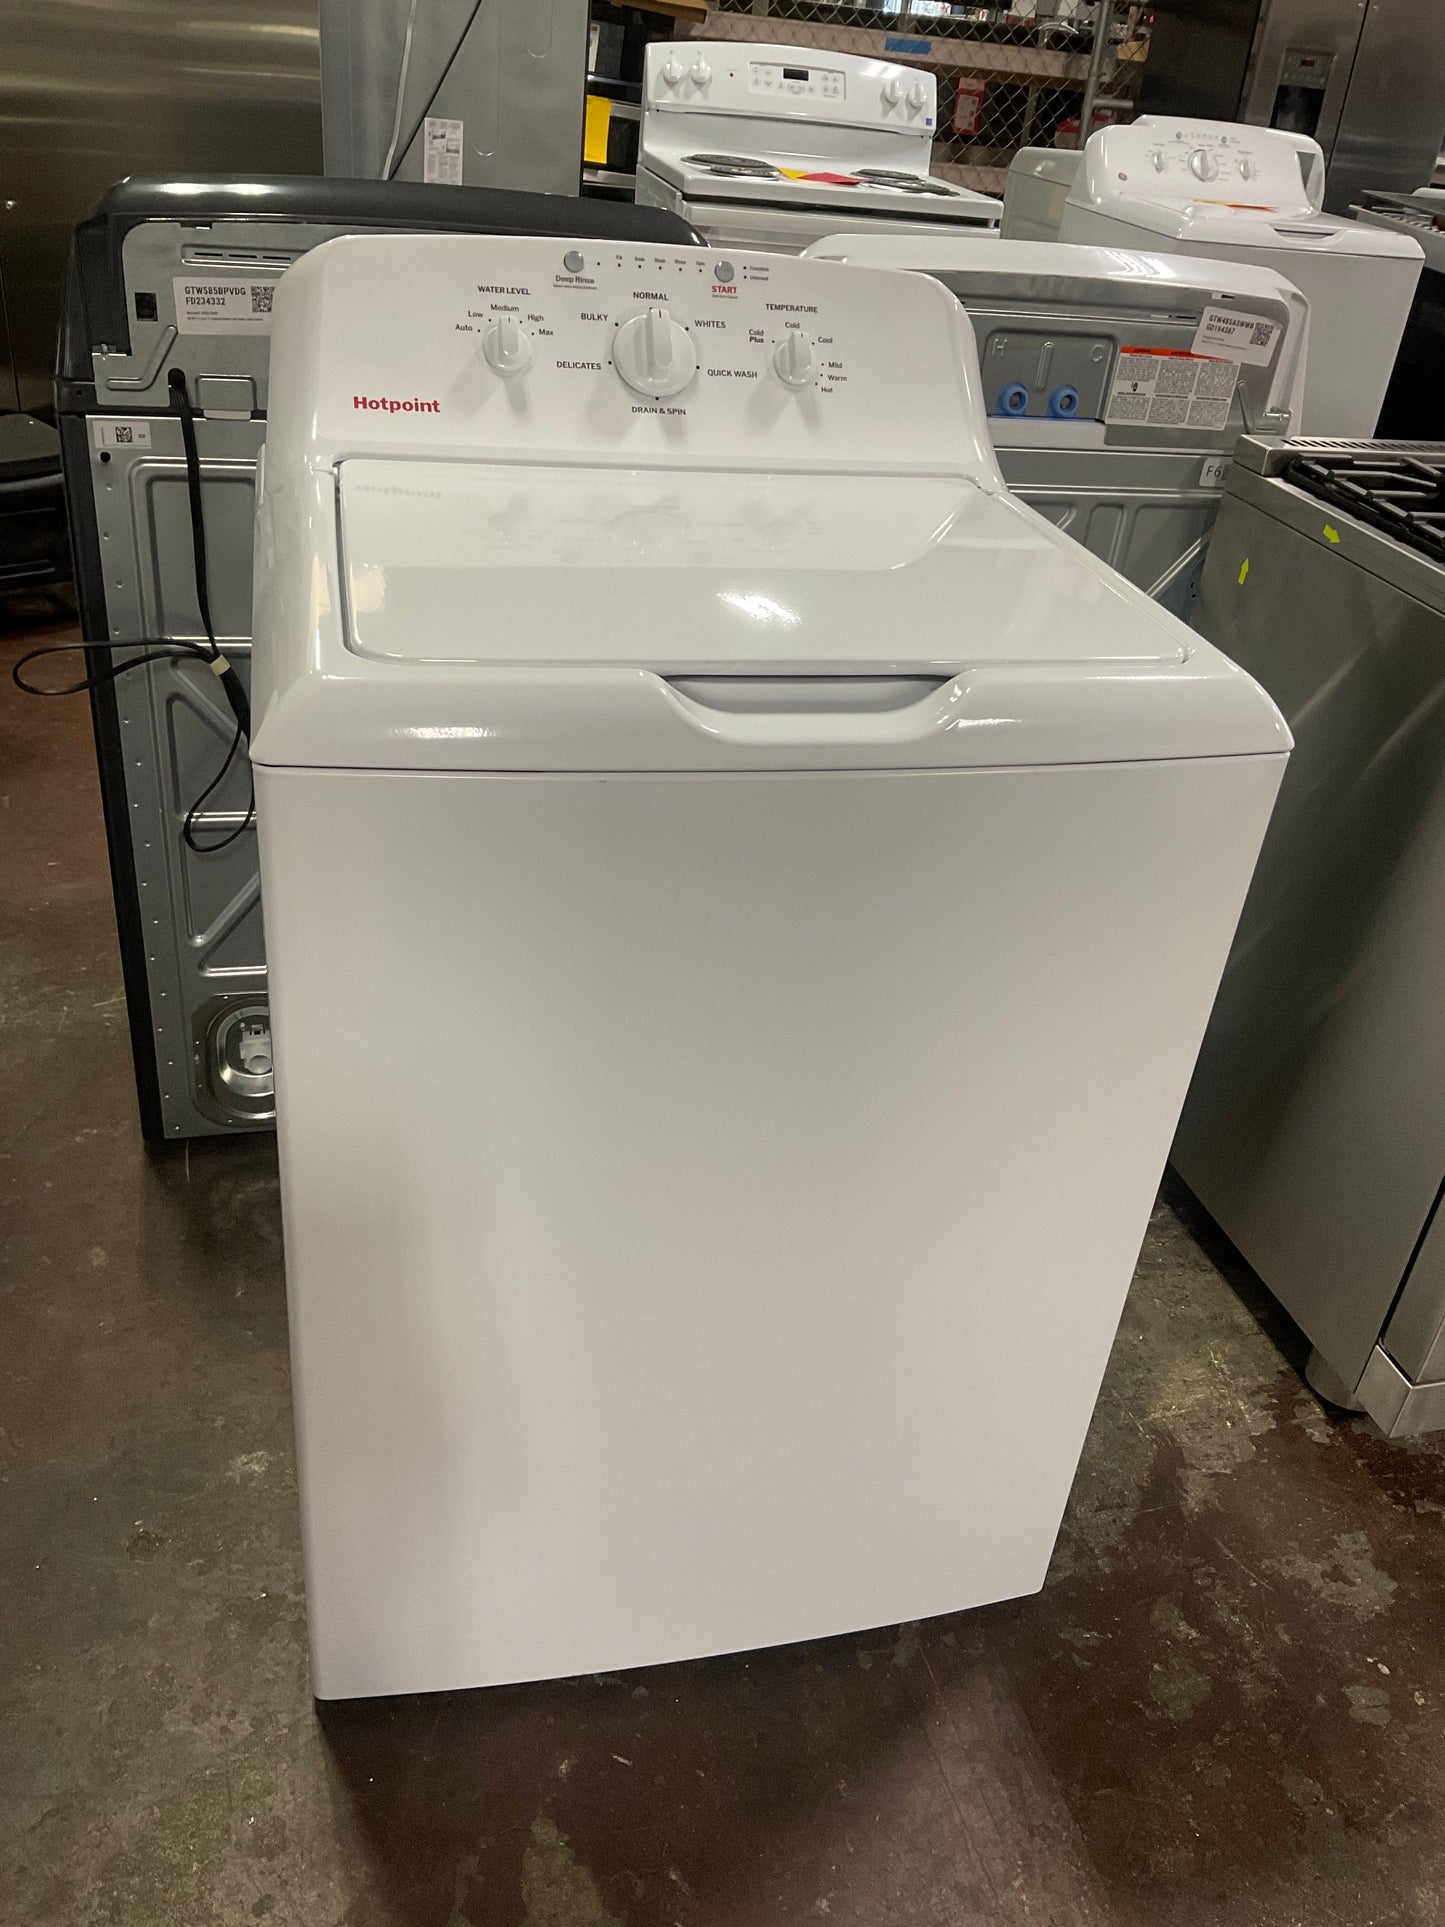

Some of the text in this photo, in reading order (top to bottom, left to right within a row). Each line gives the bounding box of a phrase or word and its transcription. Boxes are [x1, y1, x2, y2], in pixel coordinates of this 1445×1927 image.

[555, 274, 595, 284] Deep Rinse
[477, 285, 531, 296] WATER LEVEL
[712, 285, 737, 293] START
[632, 291, 669, 301] NORMAL
[185, 296, 226, 306] FD234332
[490, 303, 520, 312] Medium
[766, 304, 818, 313] TEMPERATURE
[467, 310, 484, 318] Low
[527, 314, 545, 323] High
[580, 312, 609, 322] BULKY
[454, 323, 473, 332] Auto
[694, 319, 726, 329] WHITES
[784, 321, 801, 329] Cold
[538, 328, 554, 336] Max
[748, 328, 765, 337] Cold
[749, 336, 765, 344] Plus
[817, 336, 833, 344] Cool
[556, 360, 602, 370] DELICATES
[828, 361, 843, 369] Mild
[707, 368, 758, 379] QUICK WASH
[827, 374, 848, 382] Warm
[821, 386, 834, 394] Hot
[353, 395, 441, 413] Hotpoint
[631, 405, 687, 416] DRAIN & SPIN
[1206, 465, 1222, 477] F6
